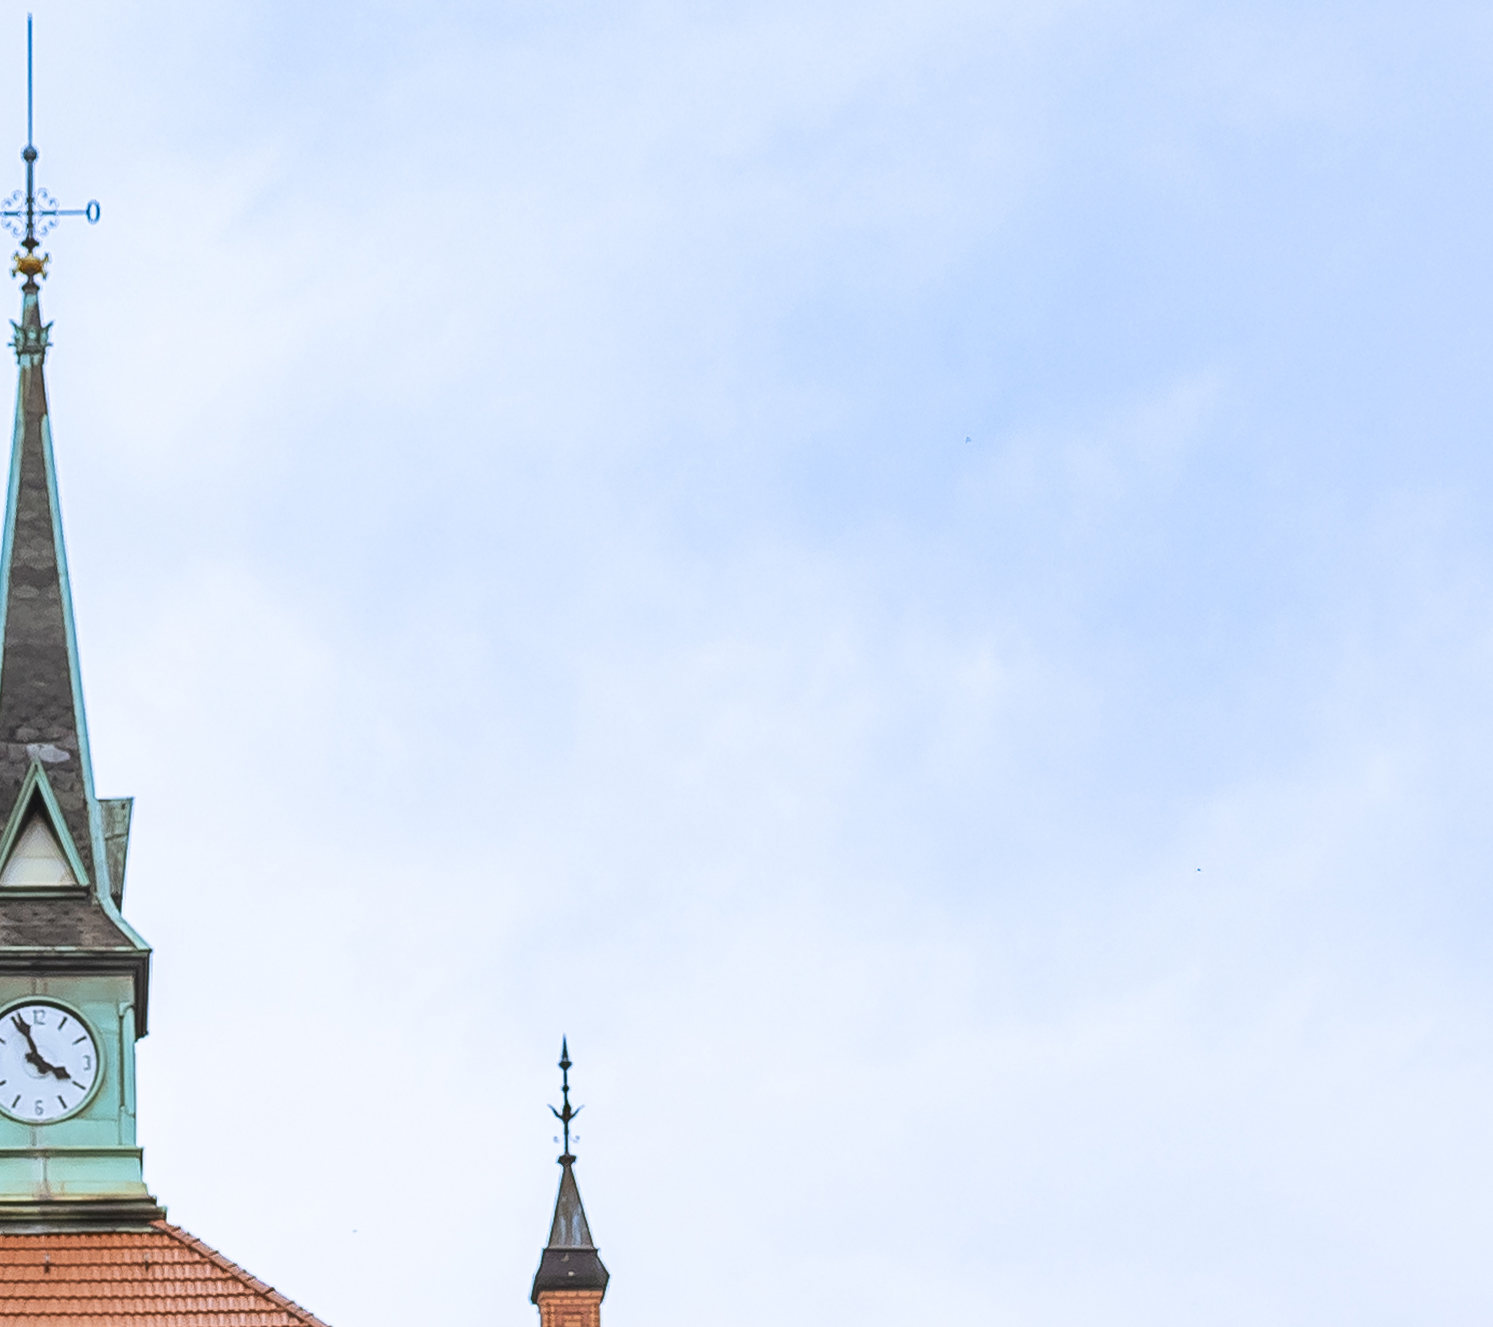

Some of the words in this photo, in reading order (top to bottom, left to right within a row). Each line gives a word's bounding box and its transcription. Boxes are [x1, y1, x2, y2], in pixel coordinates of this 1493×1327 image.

[33, 1009, 45, 1025] 12
[83, 1055, 91, 1071] 3
[34, 1099, 44, 1116] 6
